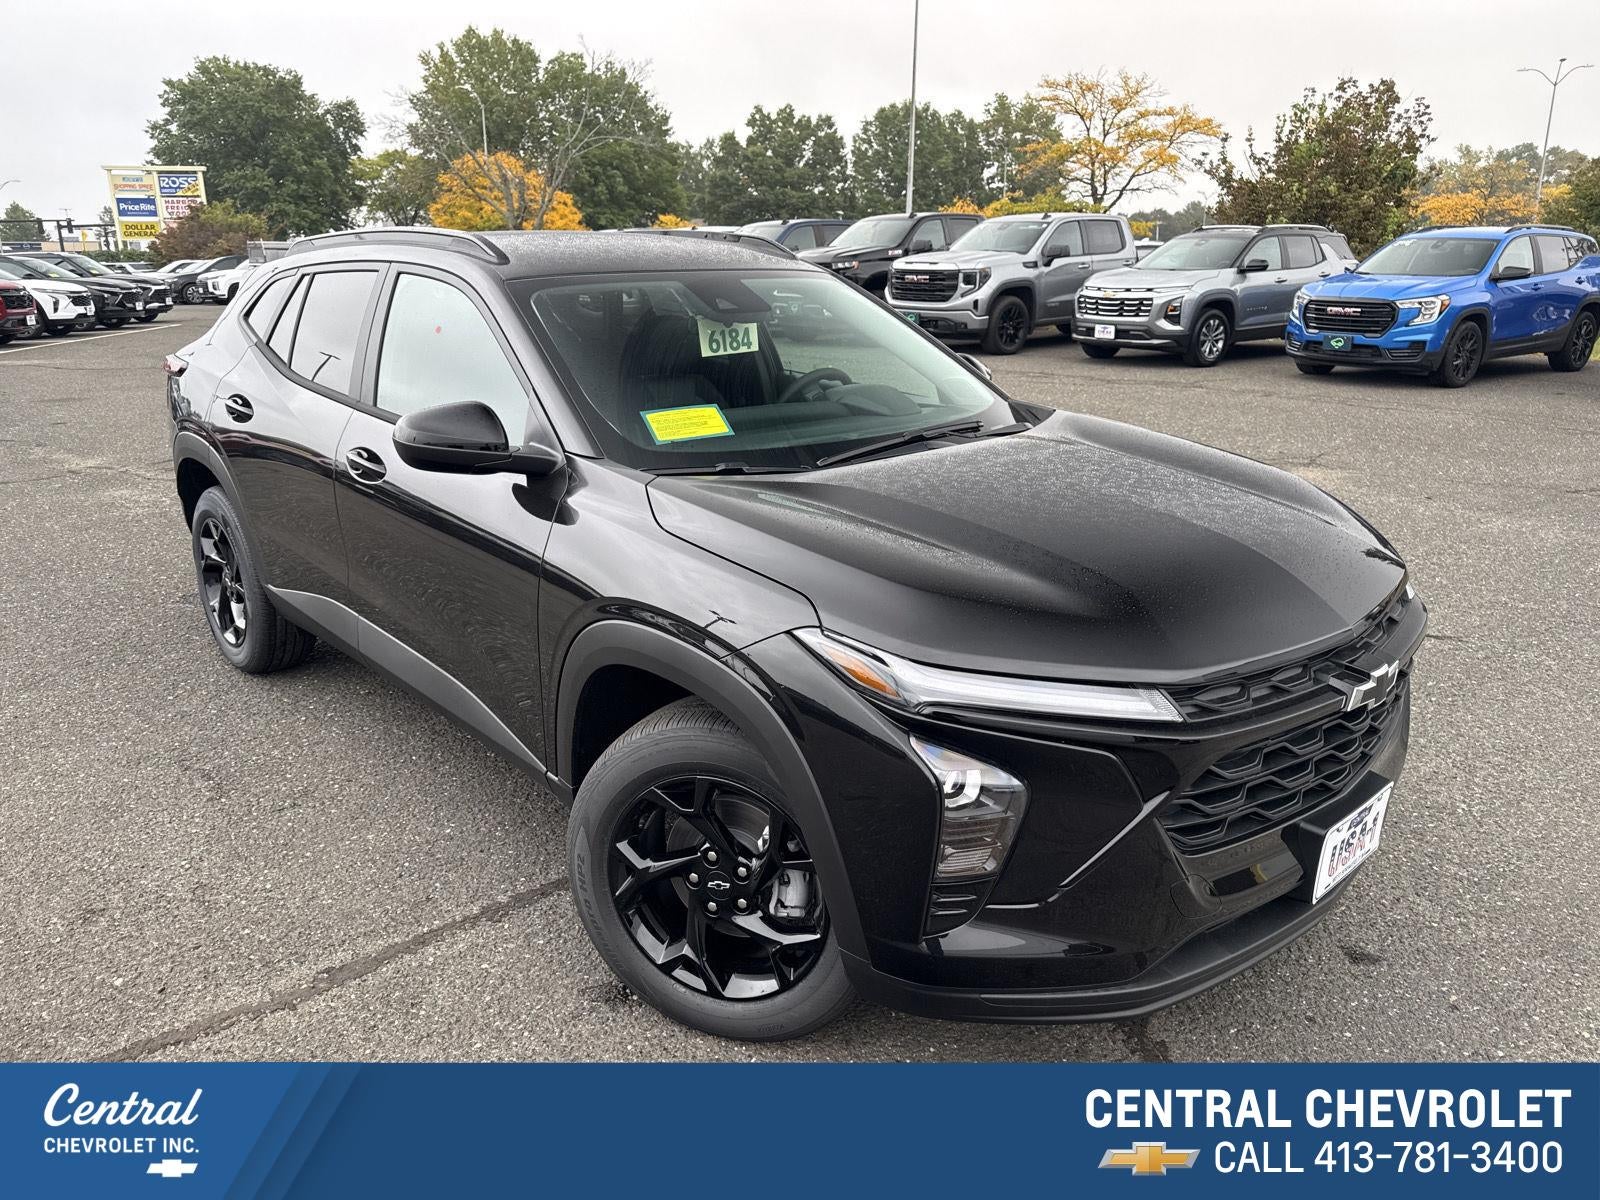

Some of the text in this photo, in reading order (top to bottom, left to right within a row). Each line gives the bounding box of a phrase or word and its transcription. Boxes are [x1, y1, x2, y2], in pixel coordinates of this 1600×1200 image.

[160, 177, 196, 188] ROSS
[905, 275, 929, 283] GMC
[1326, 306, 1361, 316] GMC
[708, 326, 752, 353] 6184
